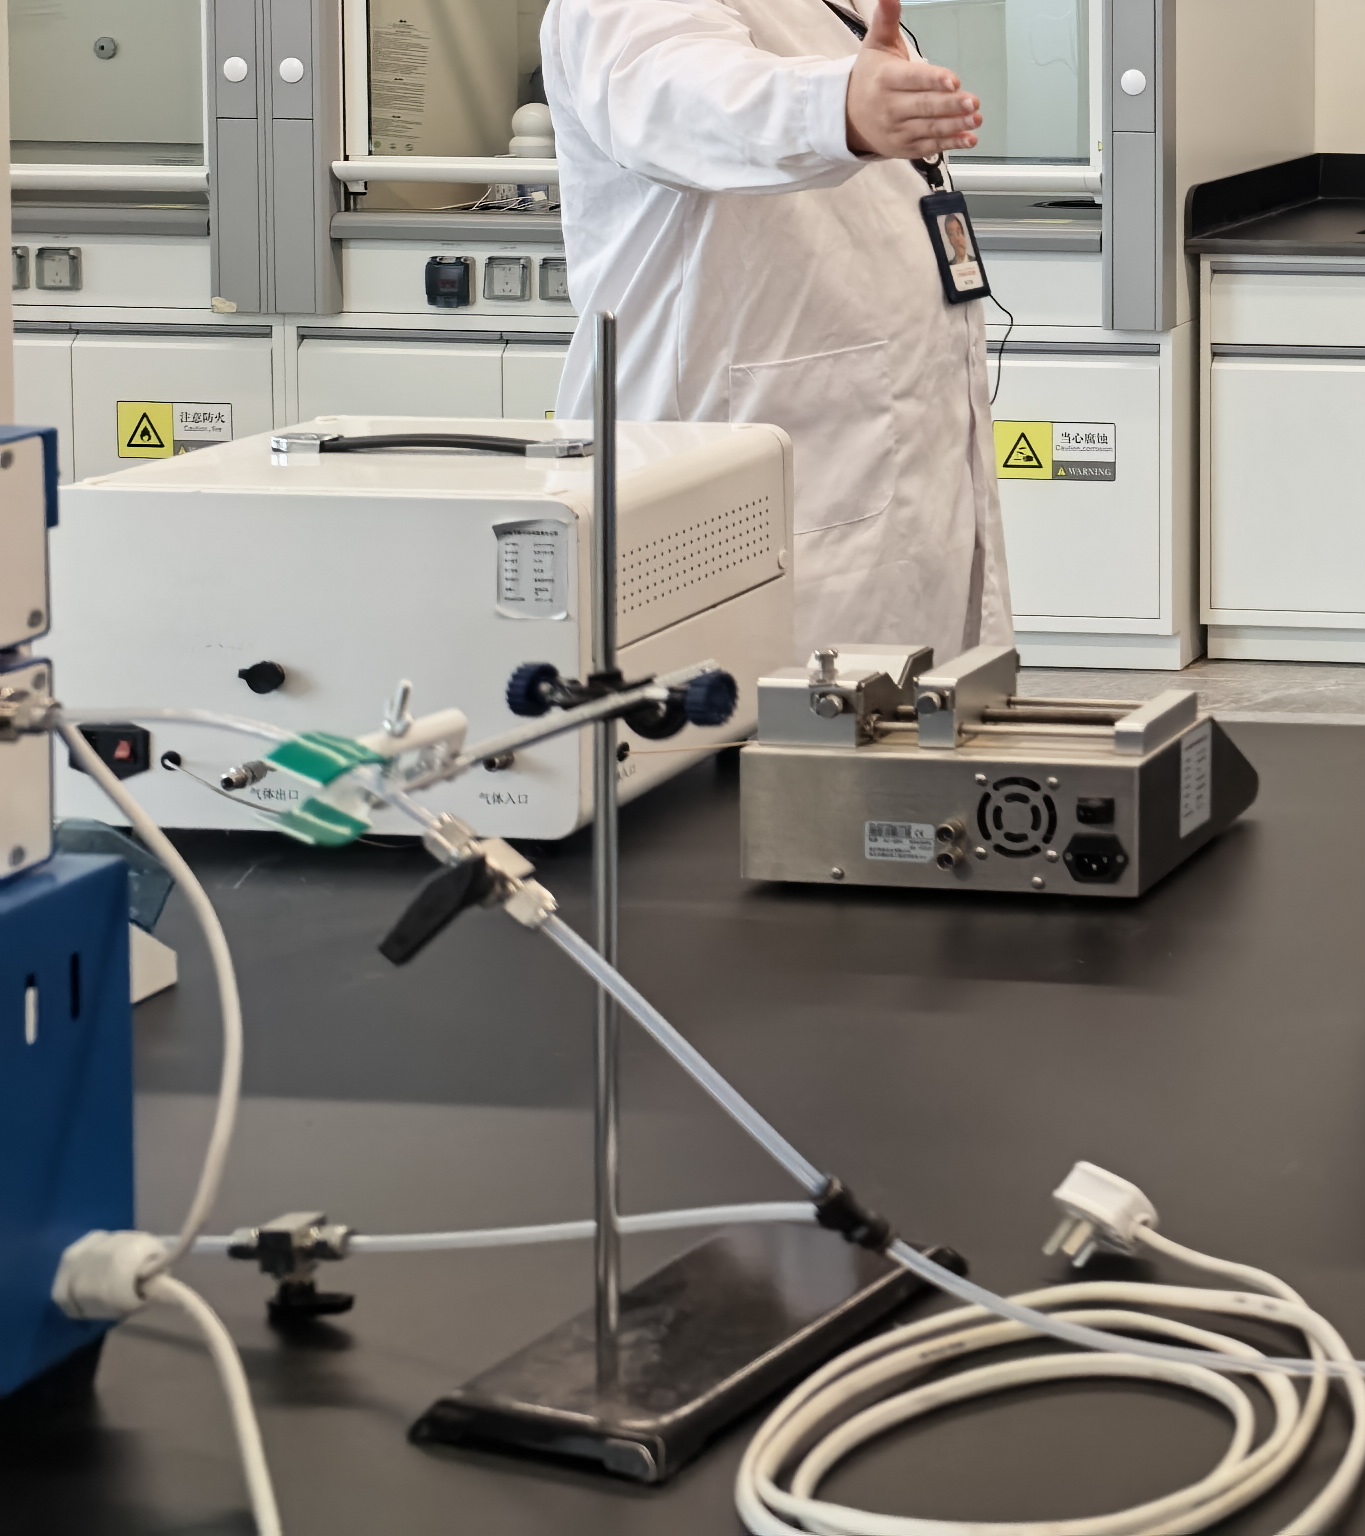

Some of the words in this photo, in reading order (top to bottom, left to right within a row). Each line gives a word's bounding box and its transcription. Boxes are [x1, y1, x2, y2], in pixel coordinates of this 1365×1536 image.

[180, 412, 225, 424] 注意防火
[1060, 432, 1108, 444] 当心腐蚀
[1068, 467, 1112, 476] WARNING
[251, 786, 299, 801] 气体出口
[479, 792, 528, 805] 气体入口
